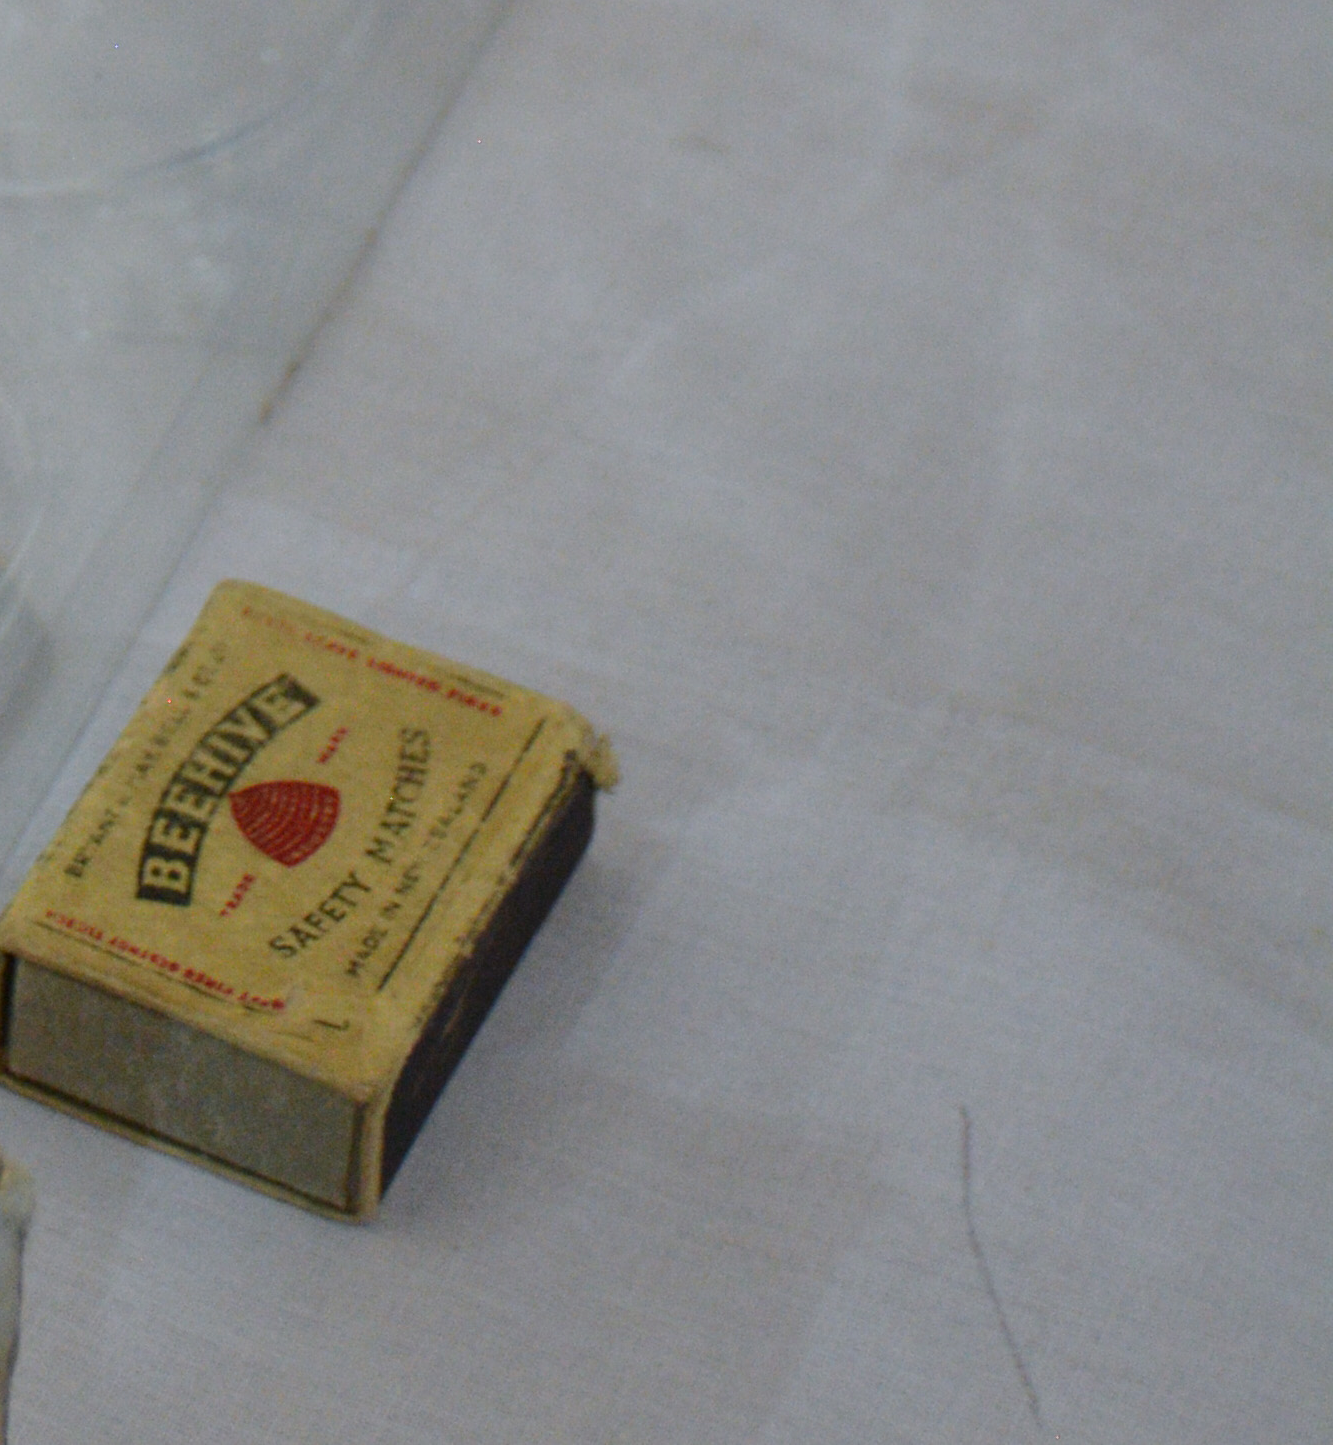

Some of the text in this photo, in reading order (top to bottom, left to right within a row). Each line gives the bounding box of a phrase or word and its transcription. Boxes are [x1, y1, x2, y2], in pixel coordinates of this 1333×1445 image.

[141, 680, 308, 897] BEEHIVE
[268, 870, 373, 959] SAFETY
[366, 726, 430, 866] MATCHES
